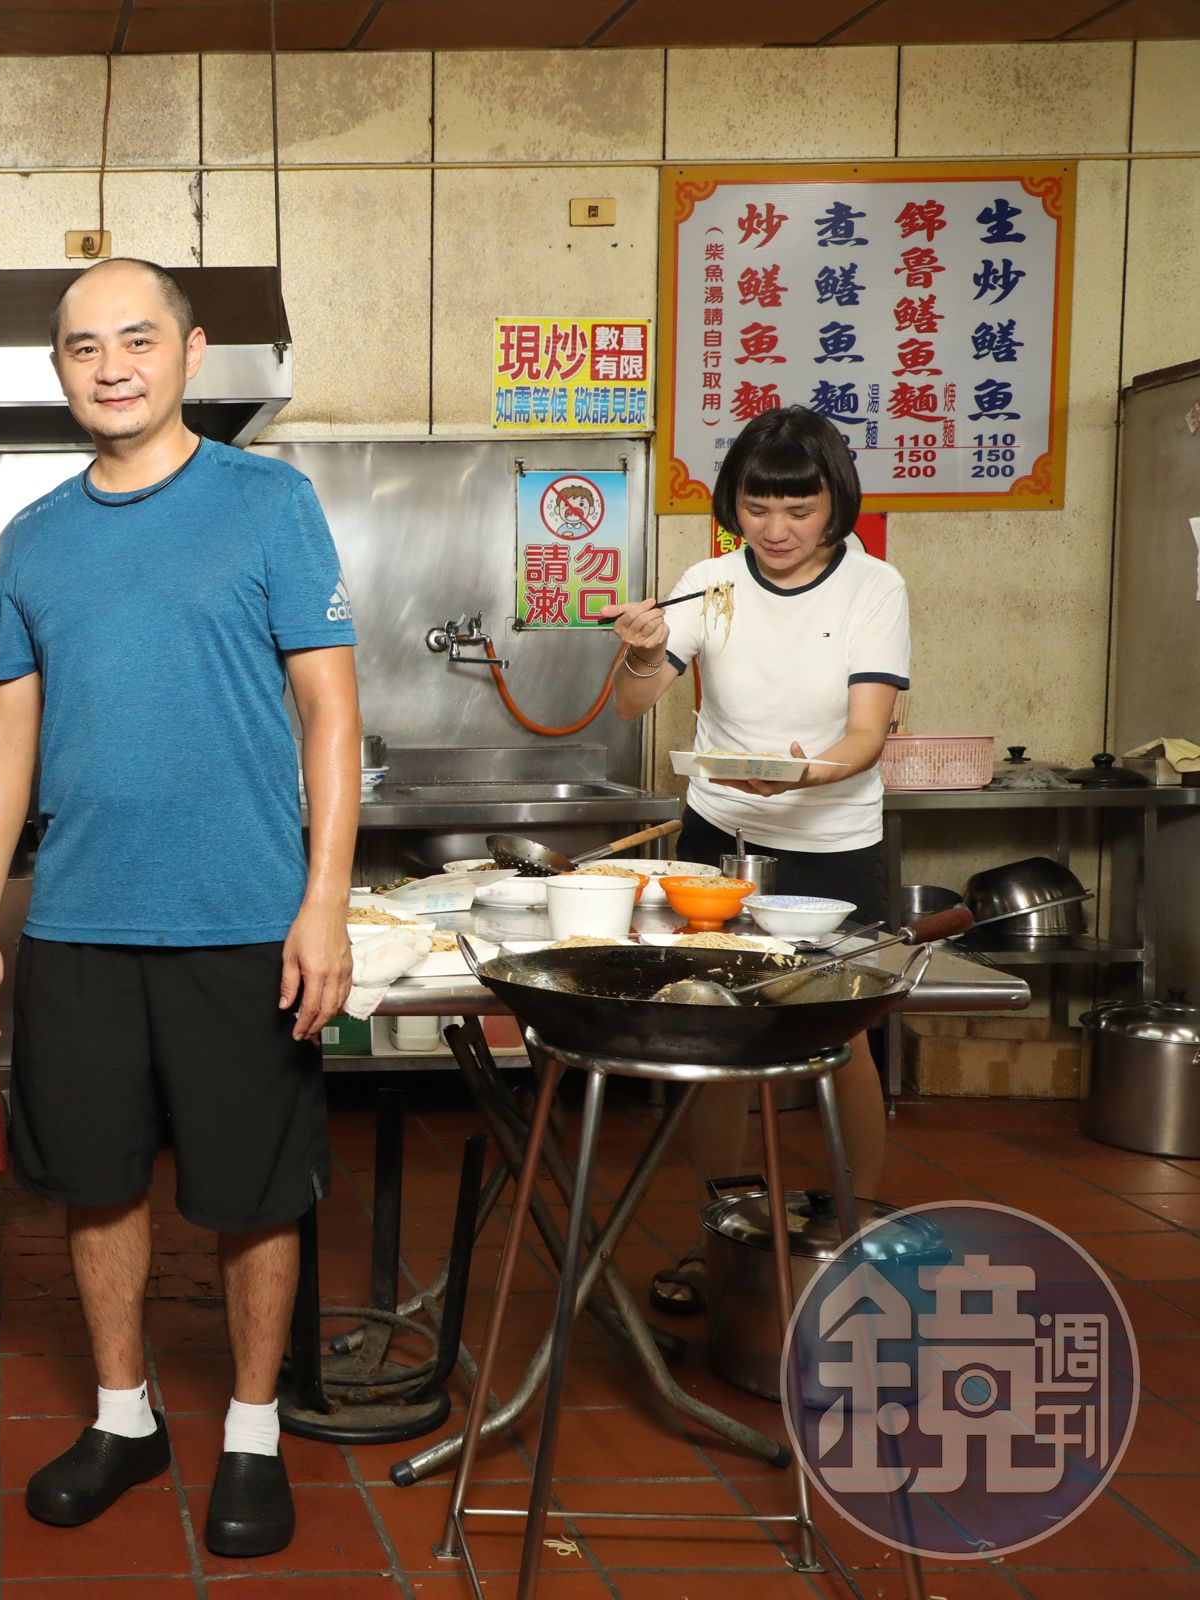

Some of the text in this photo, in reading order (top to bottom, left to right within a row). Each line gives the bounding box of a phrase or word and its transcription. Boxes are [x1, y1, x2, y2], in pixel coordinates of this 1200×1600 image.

[968, 198, 1026, 422] 生炒鱔魚
[594, 326, 644, 351] 數量
[497, 323, 588, 381] 現炒
[594, 354, 644, 380] 有限
[495, 386, 647, 424] 如需等候 敬請見諒
[894, 434, 937, 448] 110
[973, 433, 1016, 447] 110
[894, 450, 937, 463] 150
[972, 449, 1015, 462] 150
[892, 465, 936, 479] 200
[971, 465, 1015, 478] 200
[523, 543, 621, 585] 請勿
[523, 585, 618, 625] 漱口
